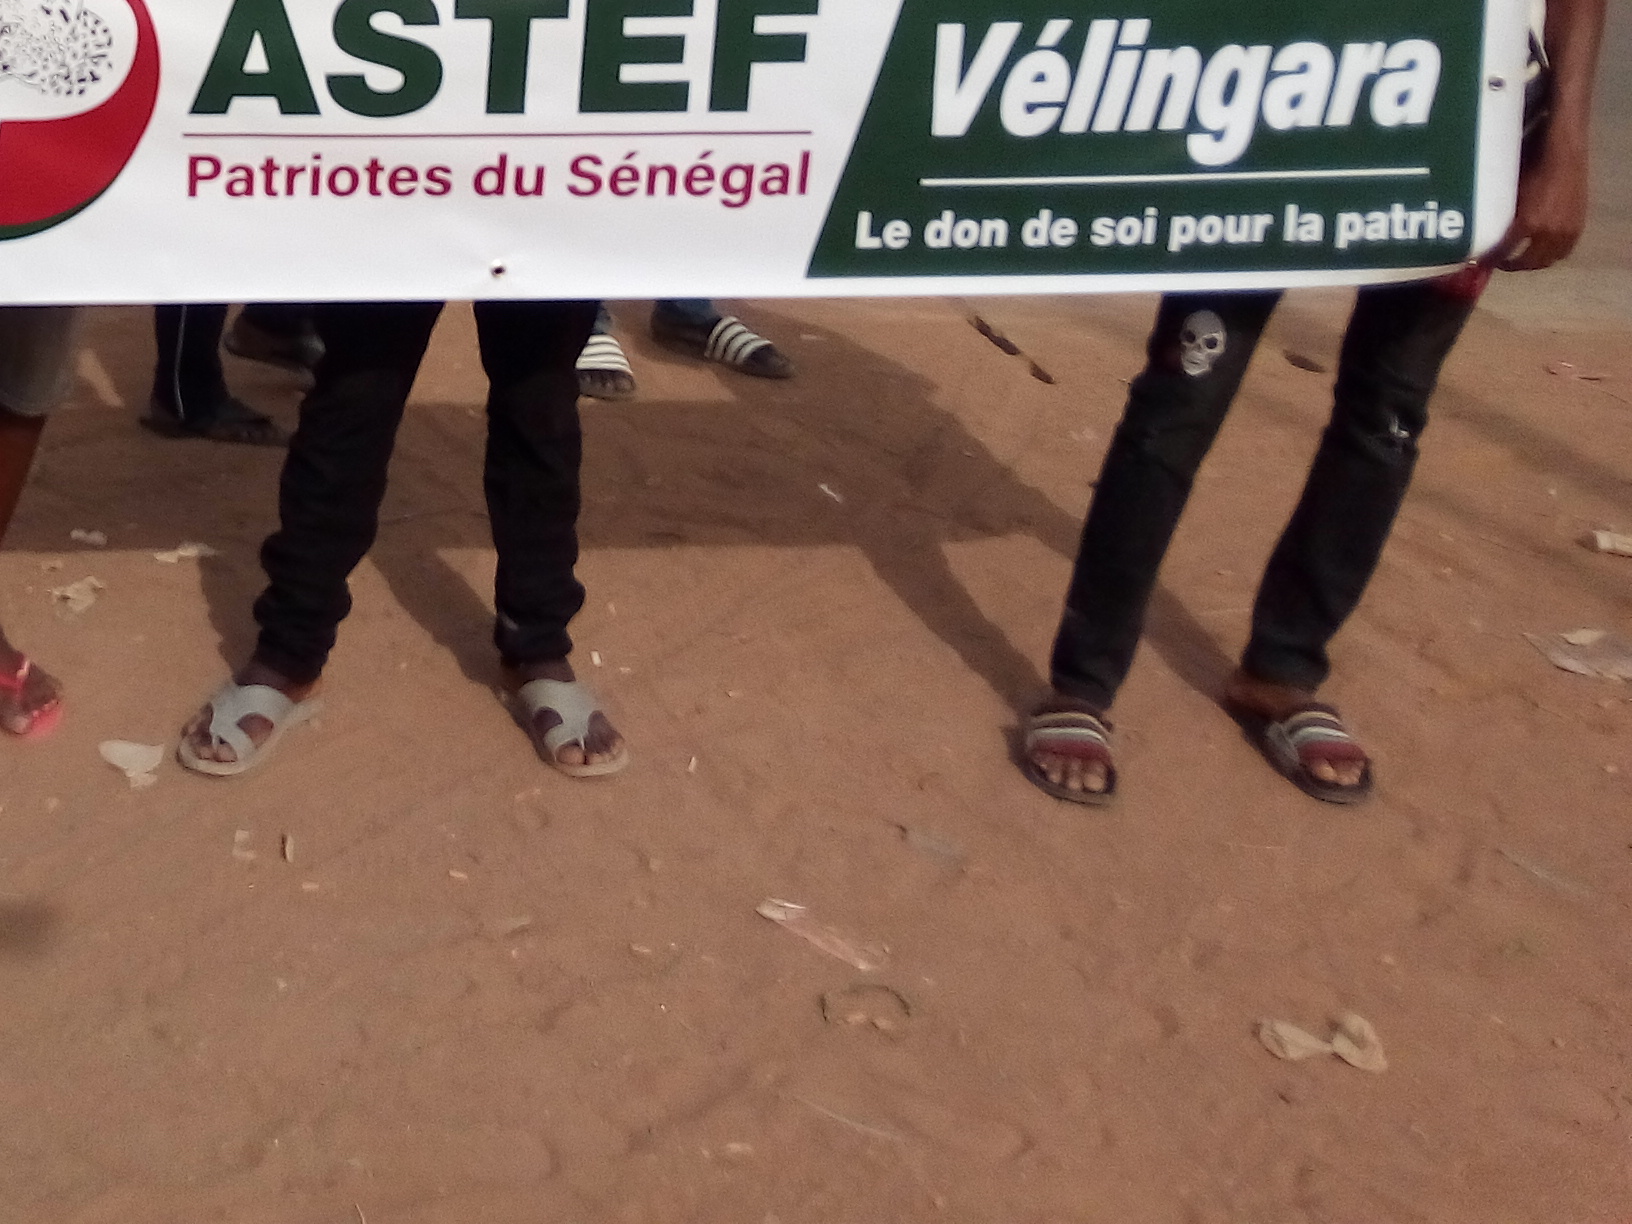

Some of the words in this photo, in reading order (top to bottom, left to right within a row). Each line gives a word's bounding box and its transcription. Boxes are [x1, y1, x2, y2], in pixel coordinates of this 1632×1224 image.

[930, 18, 1442, 166] Vélingara
[186, 153, 453, 198] Patriotes
[473, 152, 546, 197] du
[567, 150, 810, 209] Sénégal
[855, 211, 910, 250] Le
[924, 210, 1008, 249] don
[1022, 208, 1078, 247] de
[1090, 206, 1159, 246] soi
[1167, 212, 1273, 252] pour
[1284, 203, 1325, 242] la
[1335, 201, 1465, 250] patrie
